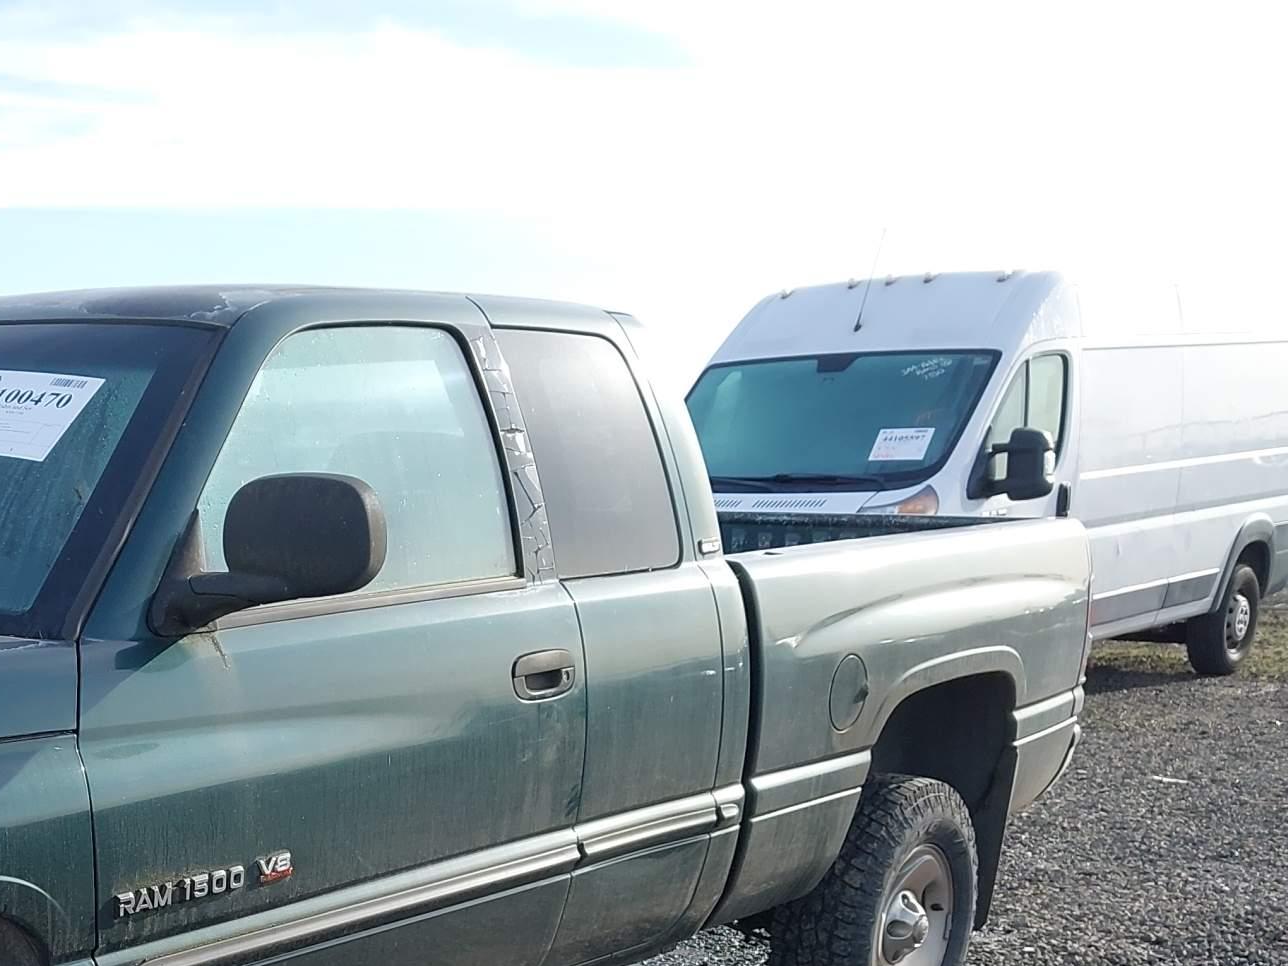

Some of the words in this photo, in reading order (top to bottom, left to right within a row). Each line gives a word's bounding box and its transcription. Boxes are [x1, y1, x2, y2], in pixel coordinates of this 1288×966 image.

[118, 882, 173, 917] RAM
[183, 865, 245, 901] 1500
[257, 851, 292, 875] V8
